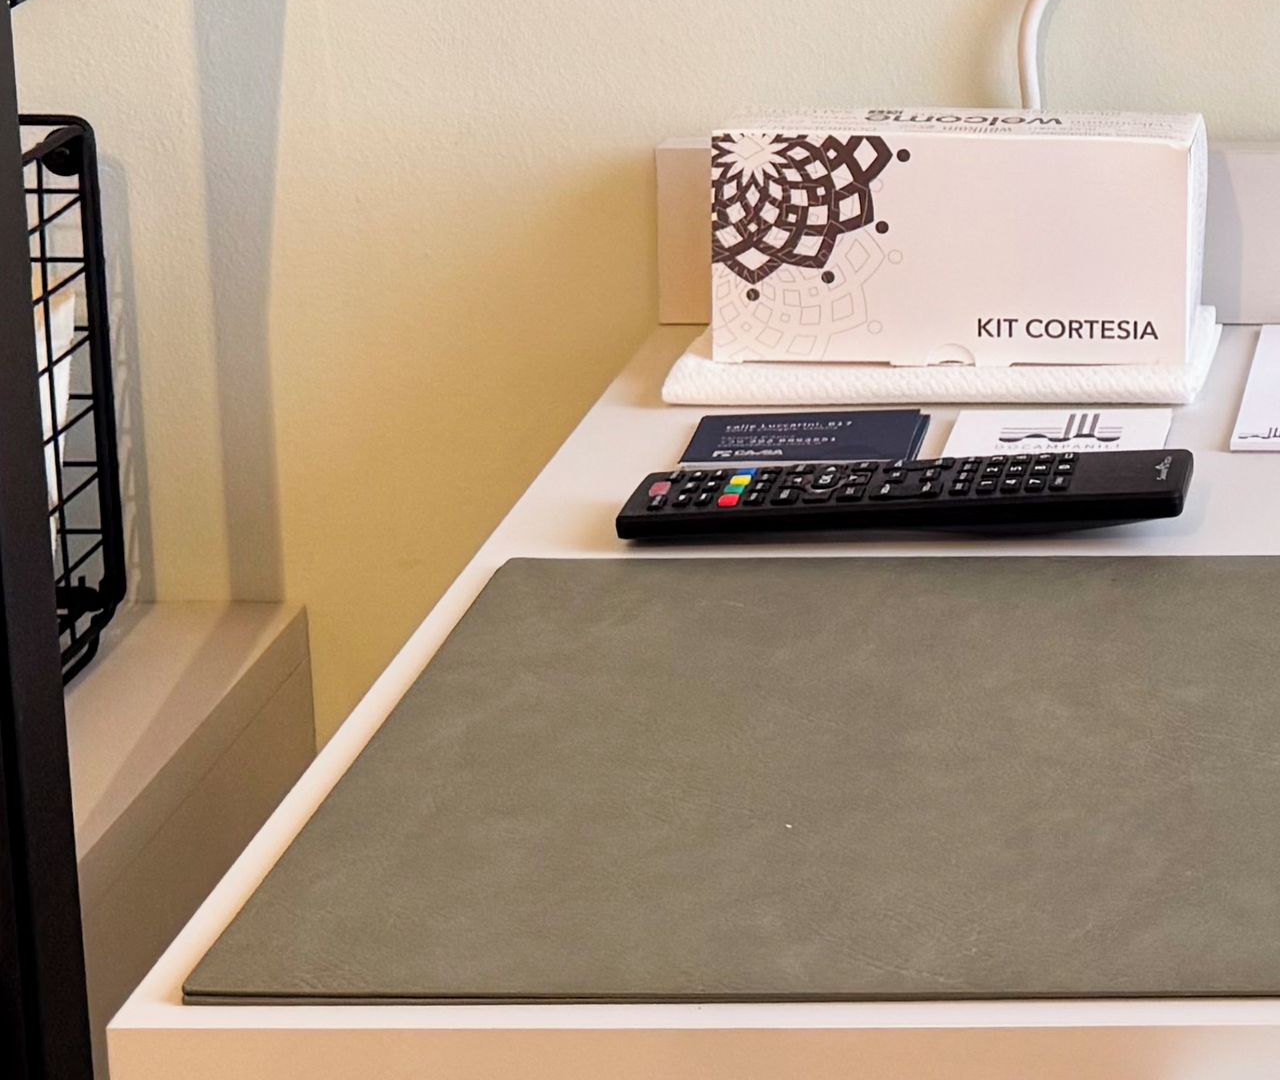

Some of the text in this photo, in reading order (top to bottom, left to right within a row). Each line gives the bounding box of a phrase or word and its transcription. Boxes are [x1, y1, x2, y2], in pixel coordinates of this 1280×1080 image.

[866, 113, 1063, 126] welcome
[977, 317, 1159, 340] KIT CORTESIA
